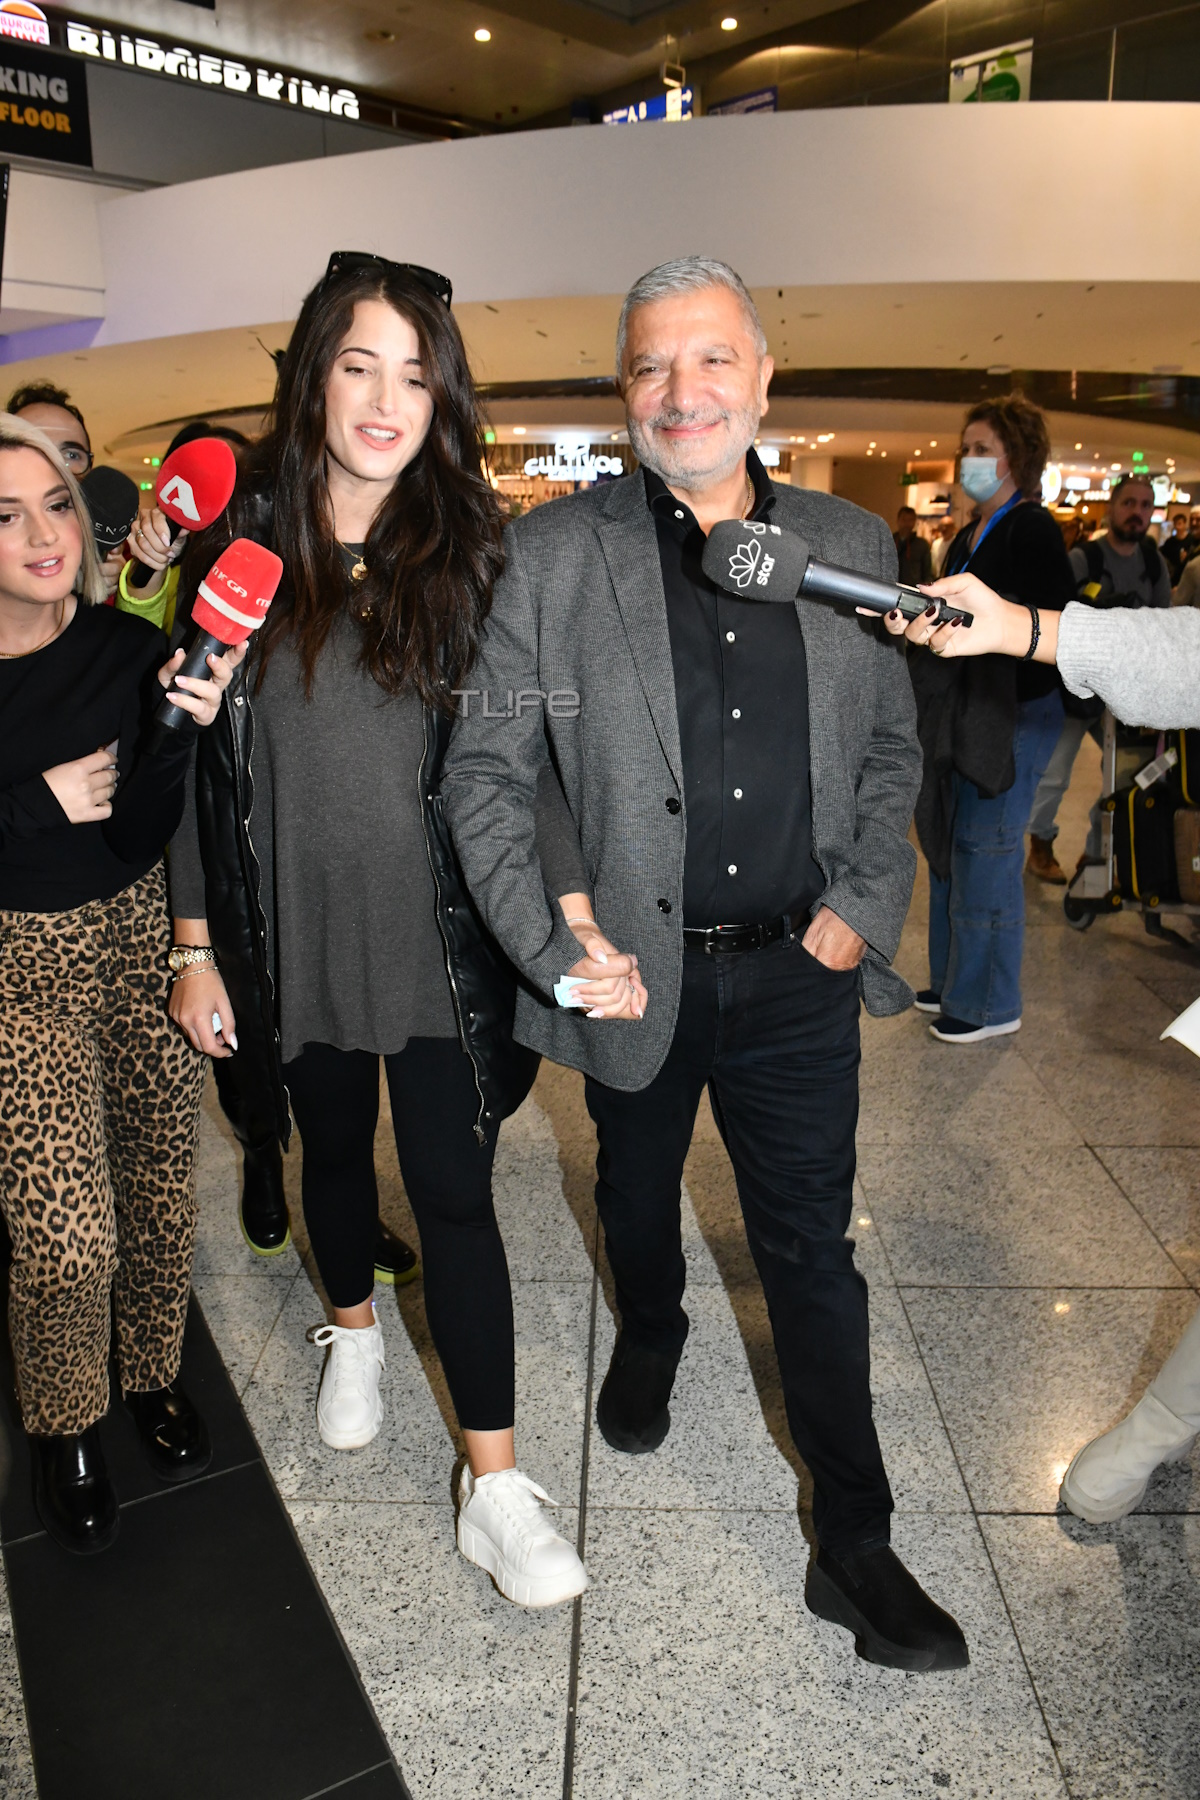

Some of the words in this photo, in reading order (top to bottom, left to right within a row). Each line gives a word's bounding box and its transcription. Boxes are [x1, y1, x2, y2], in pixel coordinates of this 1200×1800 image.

[0, 15, 45, 35] BURGER
[0, 66, 69, 103] KING
[0, 101, 71, 134] FLOOR
[524, 454, 624, 477] CULTIVOS
[757, 553, 775, 586] star
